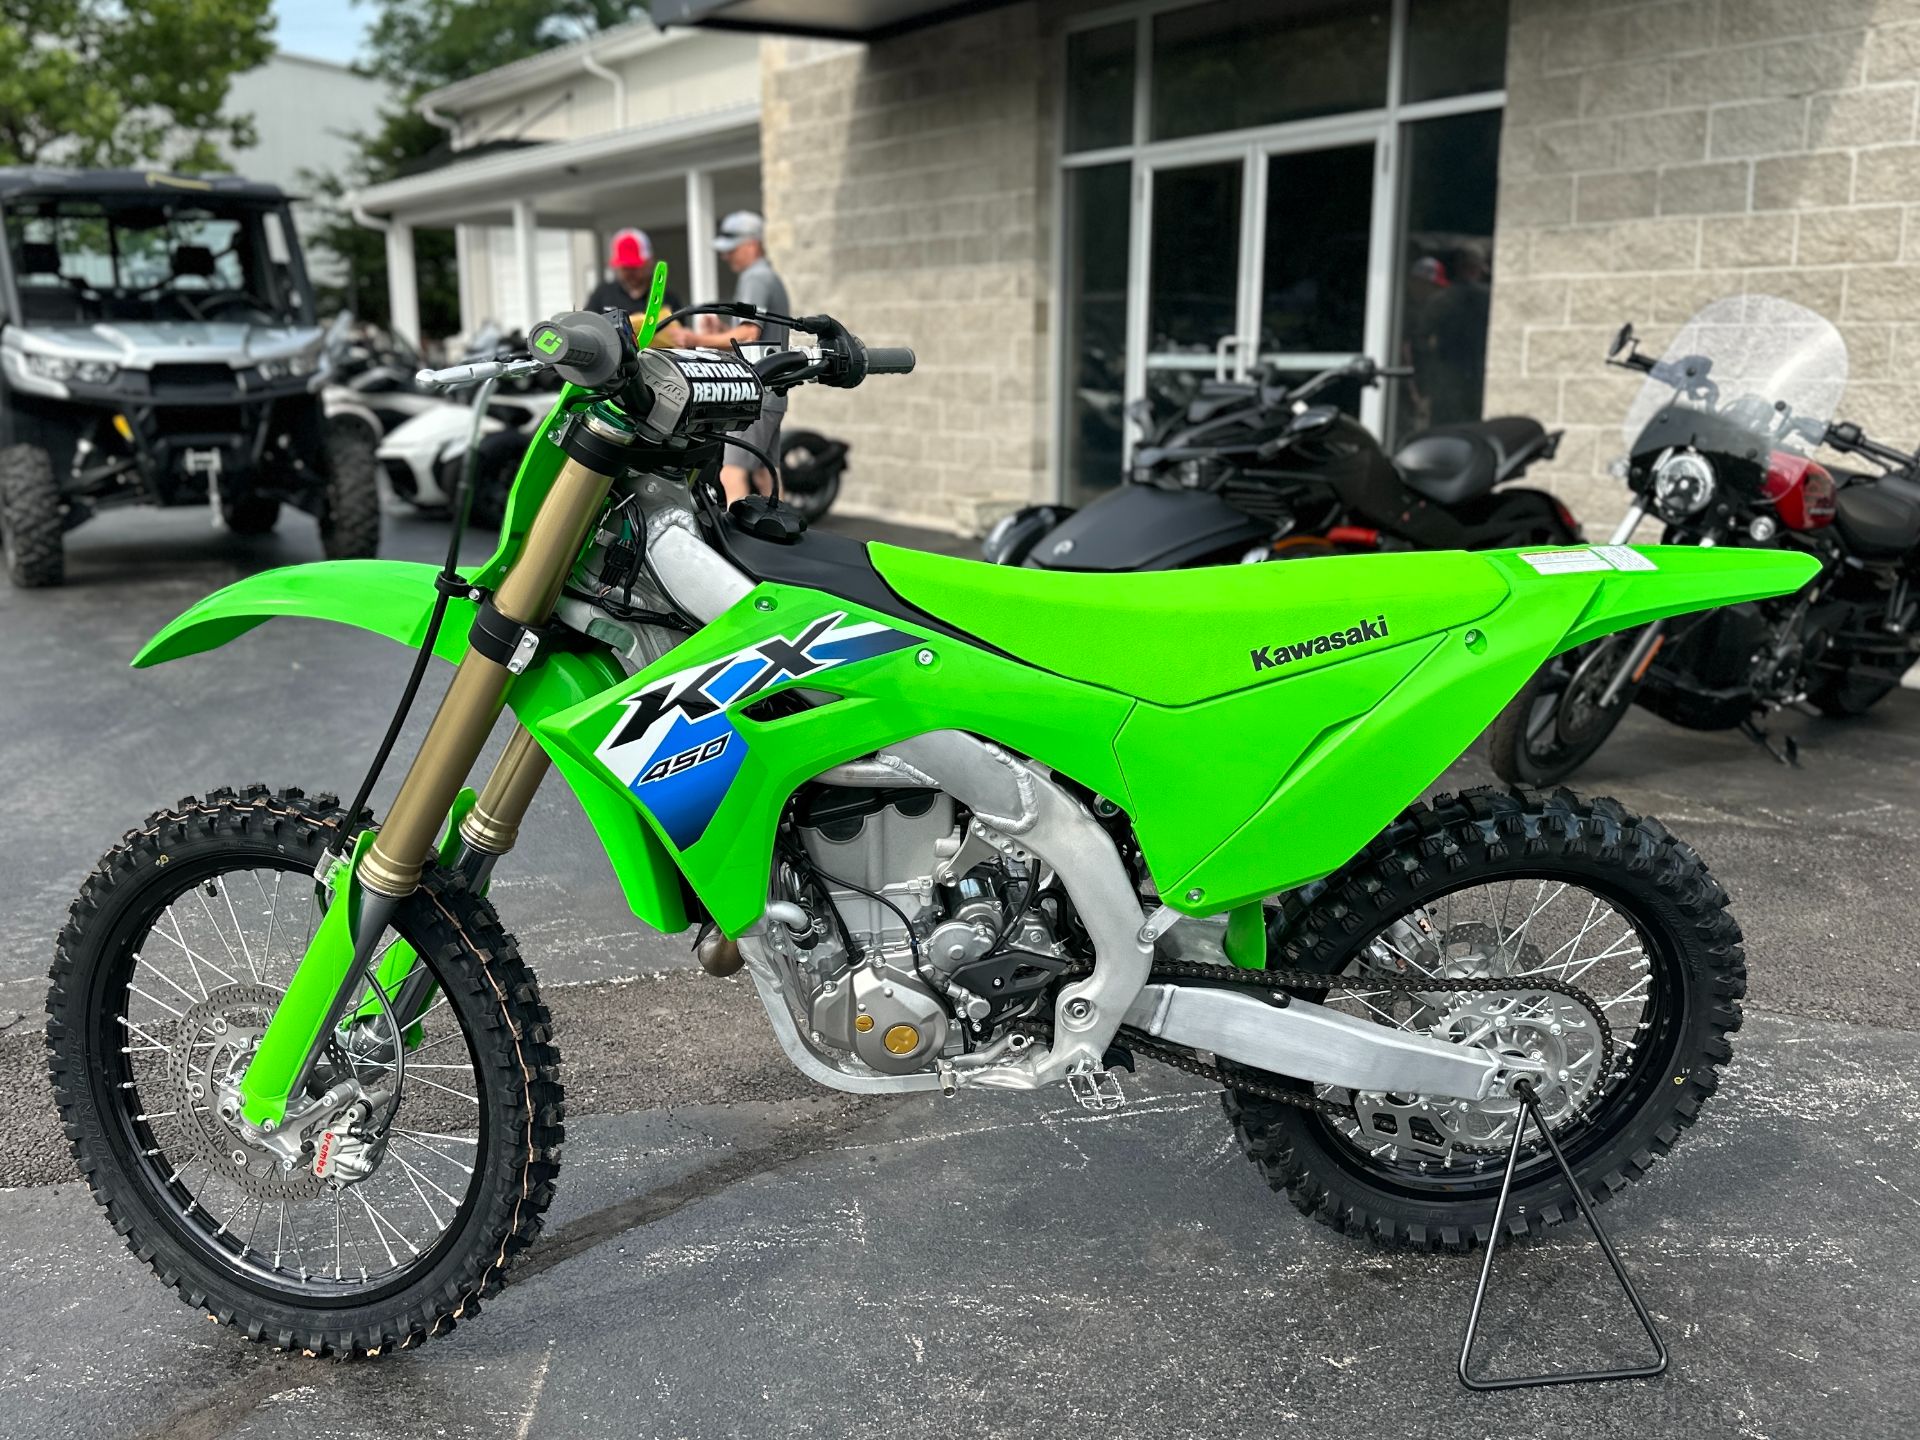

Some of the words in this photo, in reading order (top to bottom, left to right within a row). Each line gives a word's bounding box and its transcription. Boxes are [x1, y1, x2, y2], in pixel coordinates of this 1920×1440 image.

[677, 362, 753, 378] RENTHAL
[692, 381, 760, 402] RENTHAL
[1250, 614, 1389, 671] Kawasaki
[607, 611, 847, 750] KX
[638, 731, 732, 786] 450
[68, 1040, 110, 1160] DUNLOP
[315, 1132, 334, 1174] brembo
